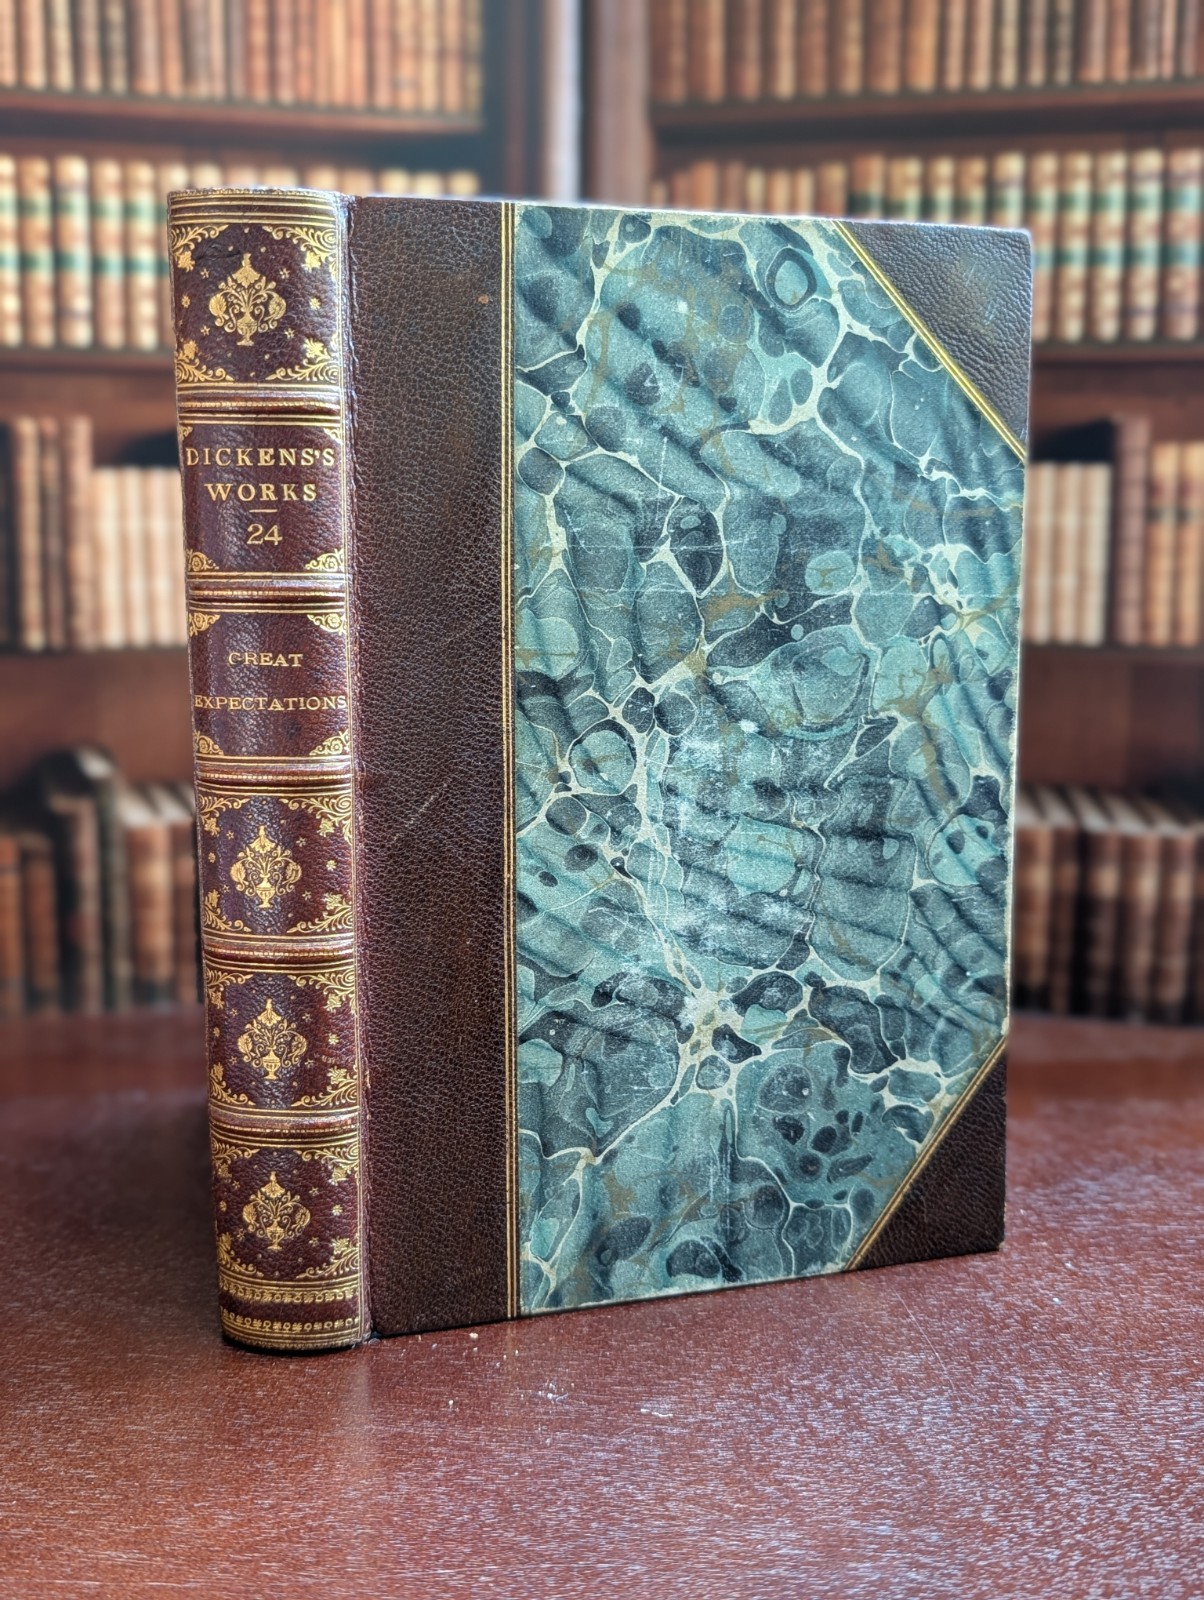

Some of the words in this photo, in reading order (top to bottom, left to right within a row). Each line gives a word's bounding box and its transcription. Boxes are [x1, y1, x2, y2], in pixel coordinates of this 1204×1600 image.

[185, 447, 335, 467] DICKENS'S
[204, 483, 317, 501] WORKS
[246, 523, 283, 546] 24
[228, 652, 304, 667] GREAT
[194, 694, 347, 711] EXPECTATIONS
